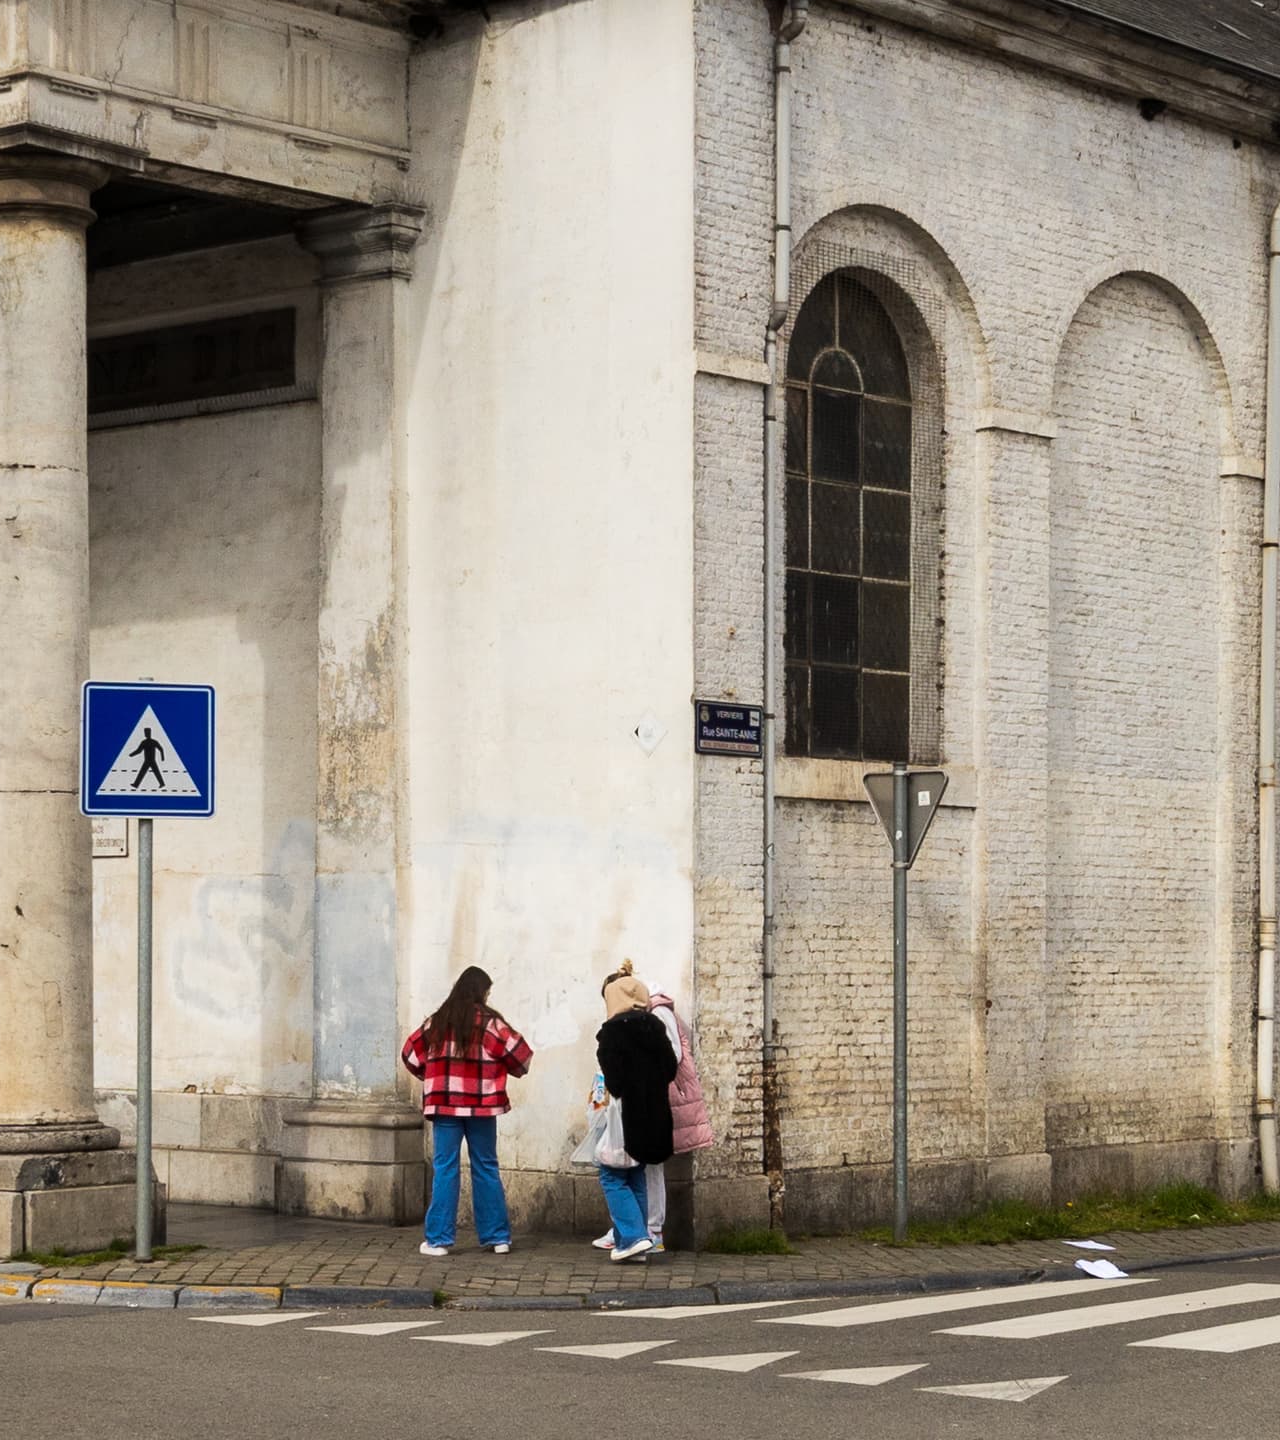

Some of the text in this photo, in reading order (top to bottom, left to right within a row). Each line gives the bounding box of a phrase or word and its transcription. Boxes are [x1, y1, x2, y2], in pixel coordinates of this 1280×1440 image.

[716, 711, 744, 720] VERVIERS
[703, 726, 757, 740] Rue SAINTE-ANNE
